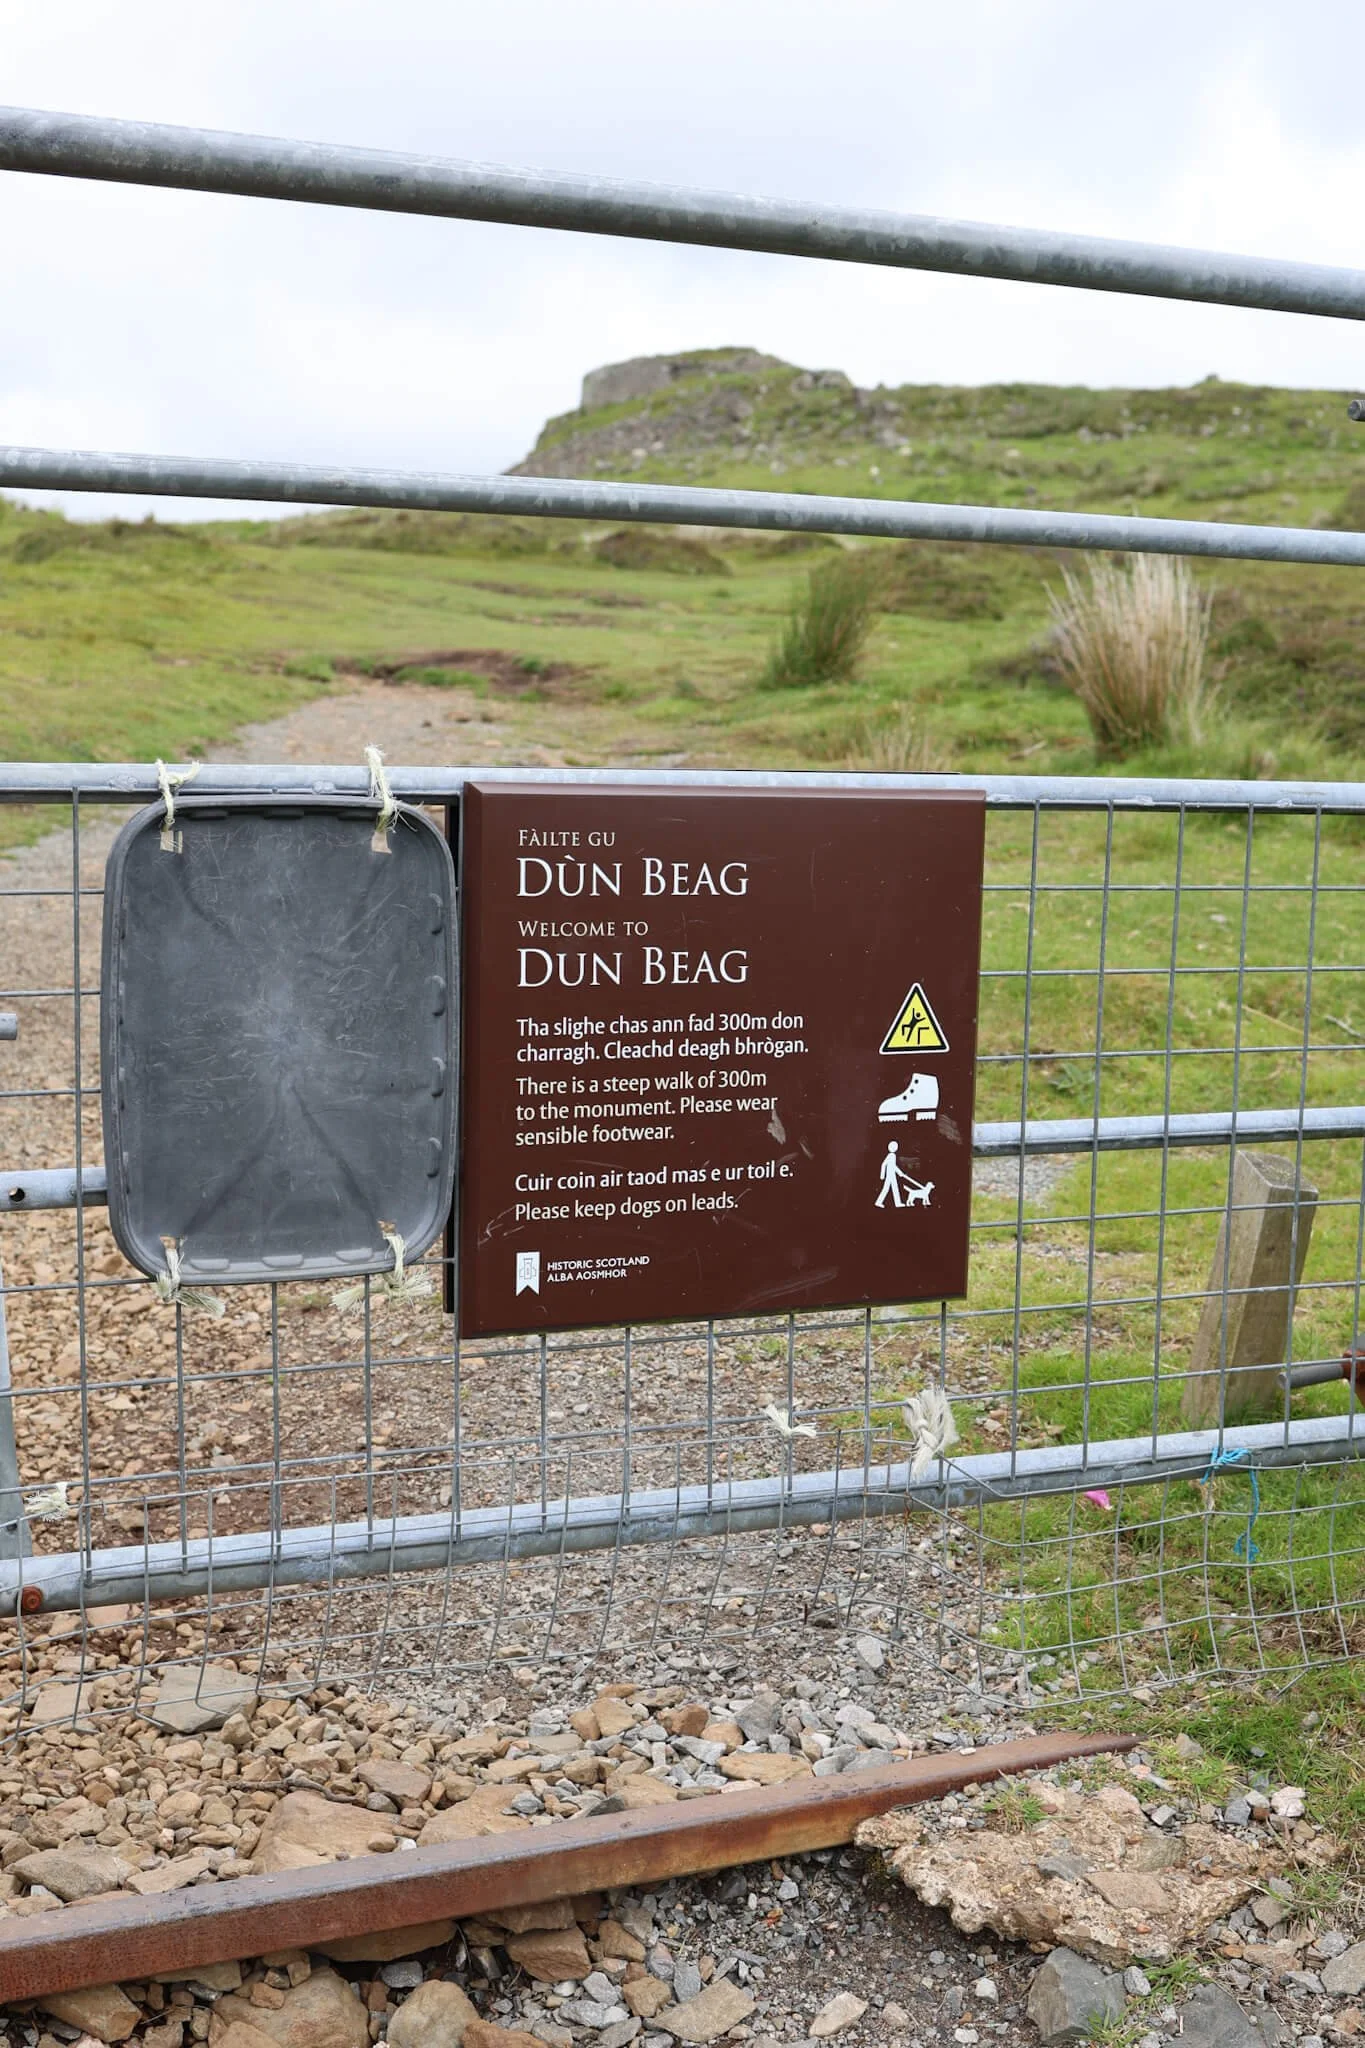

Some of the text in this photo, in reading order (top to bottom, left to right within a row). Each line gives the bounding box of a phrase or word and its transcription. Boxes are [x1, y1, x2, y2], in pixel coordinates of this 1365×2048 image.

[518, 828, 615, 847] FÀILTE GU
[517, 854, 749, 896] DÙN BEAG
[518, 921, 648, 936] WELCOME TO
[517, 947, 748, 987] DUN BEAG
[516, 1011, 803, 1039] Tha slighe chas ann fad 300m don
[517, 1037, 808, 1065] charragh. Cleachd deagh bhrògan.
[516, 1070, 766, 1095] There is a steep walk of 300m
[516, 1096, 778, 1120] to the monument. Please wear
[516, 1124, 674, 1145] sensible footwear.
[515, 1160, 793, 1191] Cuir coin air taod mas e ur toil e.
[516, 1191, 738, 1220] Please keep dogs on leads.
[547, 1256, 649, 1271] HISTORIC SCOTLAND
[547, 1269, 627, 1282] ALBA AOSMHOR
